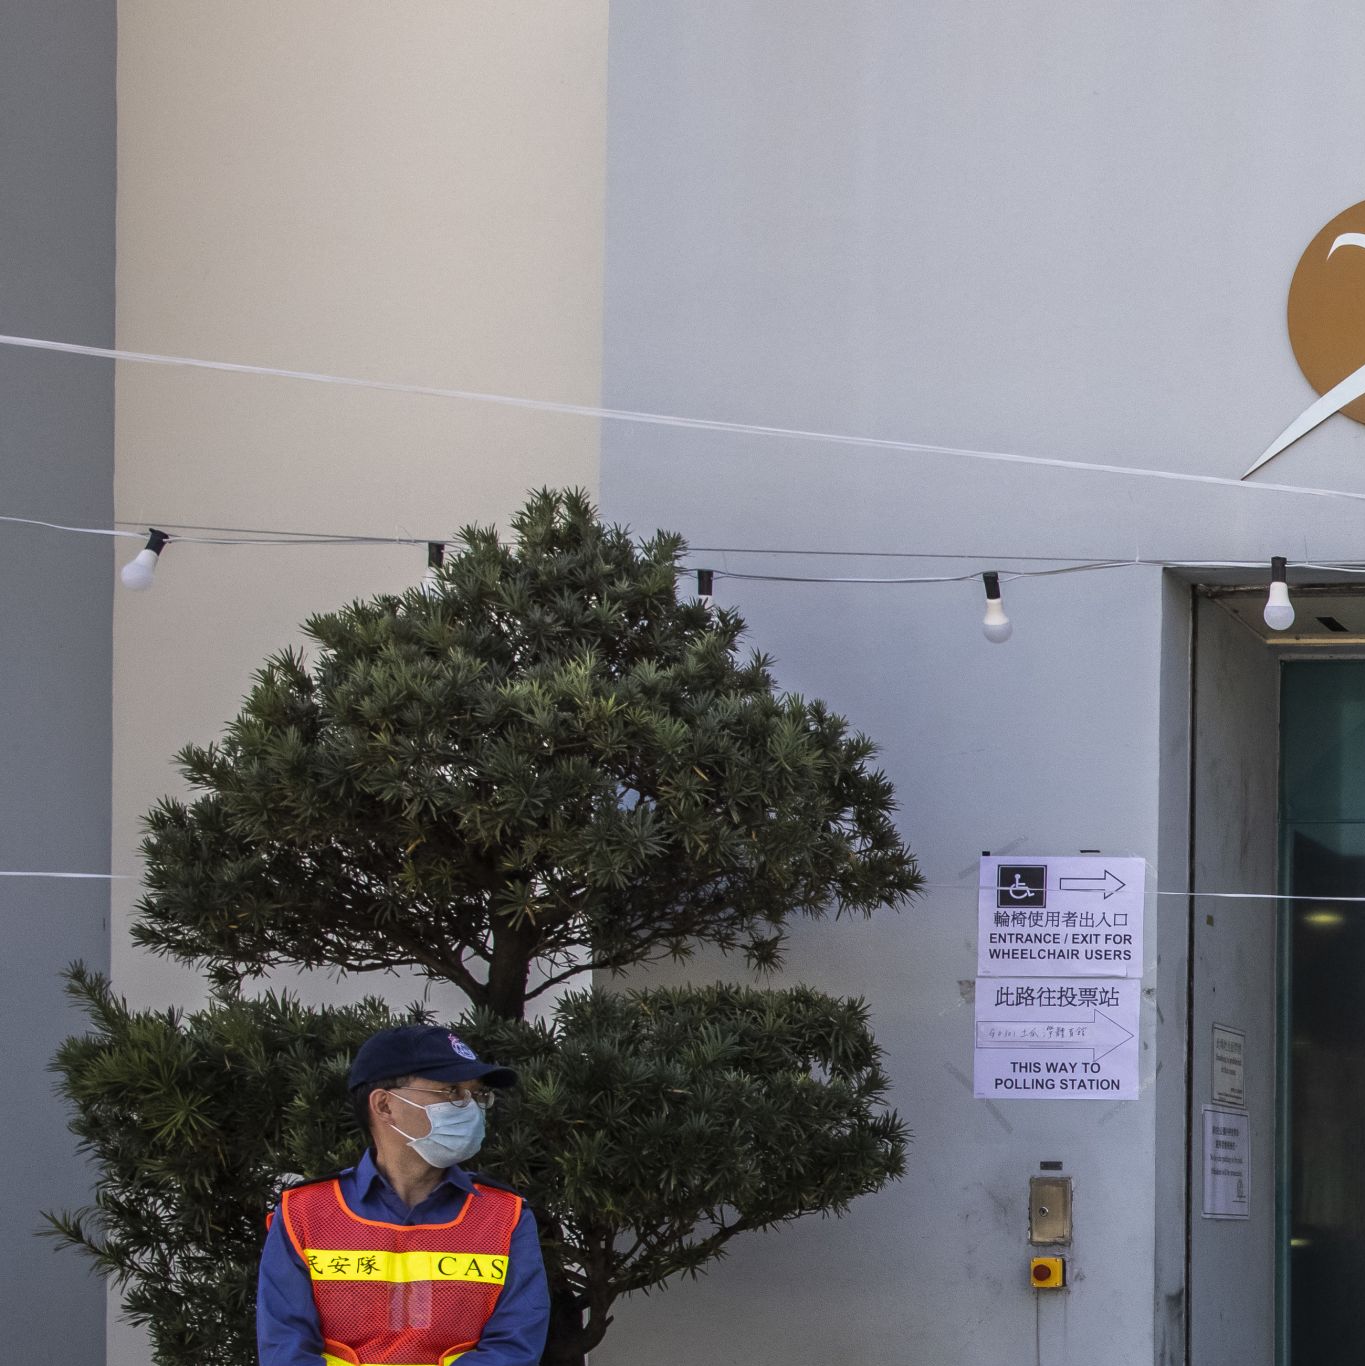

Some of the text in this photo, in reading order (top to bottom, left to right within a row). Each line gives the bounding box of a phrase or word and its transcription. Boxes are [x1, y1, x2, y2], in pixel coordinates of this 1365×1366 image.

[993, 910, 1128, 928] 輪椅使用者出入口
[989, 933, 1061, 944] ENTRANCE
[1072, 933, 1101, 944] EXIT
[1104, 934, 1132, 945] FOR
[989, 949, 1132, 961] WHEELCHAIR USERS
[994, 986, 1120, 1008] 此路往投票站
[1011, 1062, 1101, 1074] THIS WAY TO
[994, 1078, 1120, 1090] POLLING STATION
[307, 1255, 381, 1275] 民安隊
[437, 1255, 505, 1281] CAS
